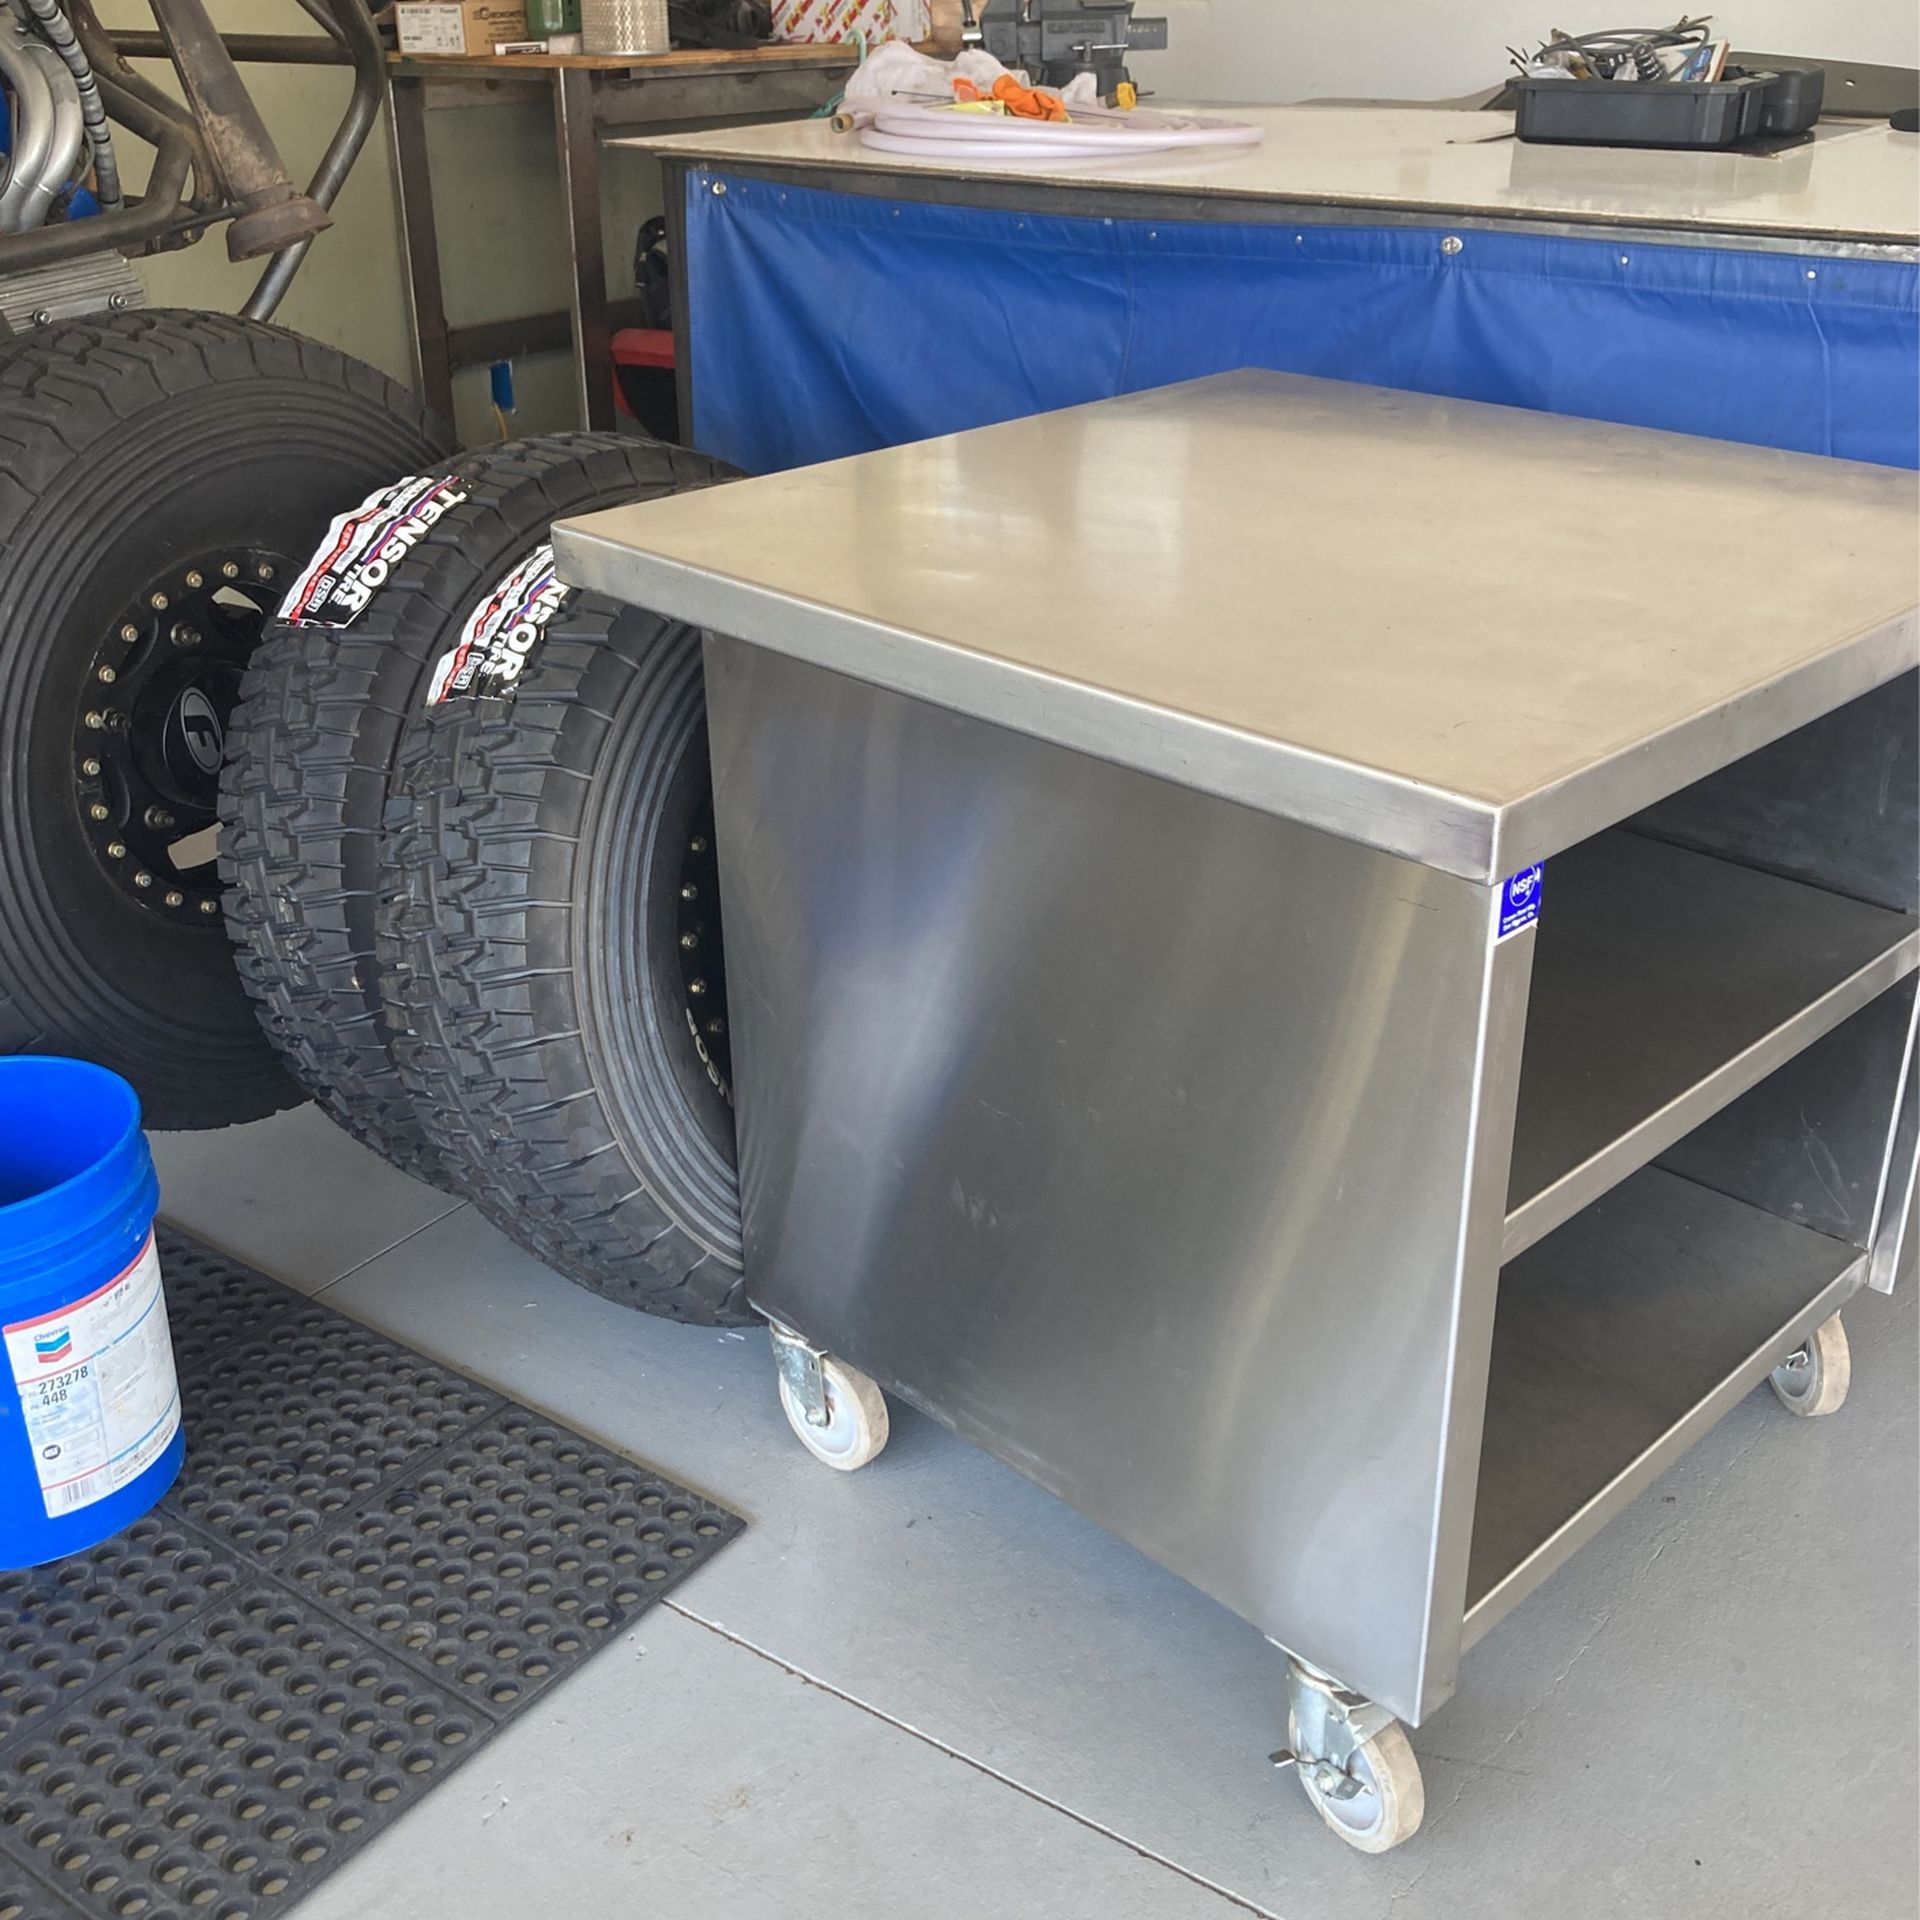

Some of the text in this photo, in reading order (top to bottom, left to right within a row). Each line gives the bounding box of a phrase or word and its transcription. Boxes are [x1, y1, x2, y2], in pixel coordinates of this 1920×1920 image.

[340, 489, 467, 611] TENSOR
[491, 576, 570, 680] NSOR
[1512, 875, 1535, 897] NSF
[34, 1324, 70, 1341] Chevron
[38, 1366, 88, 1394] 273278
[42, 1389, 68, 1406] 448
